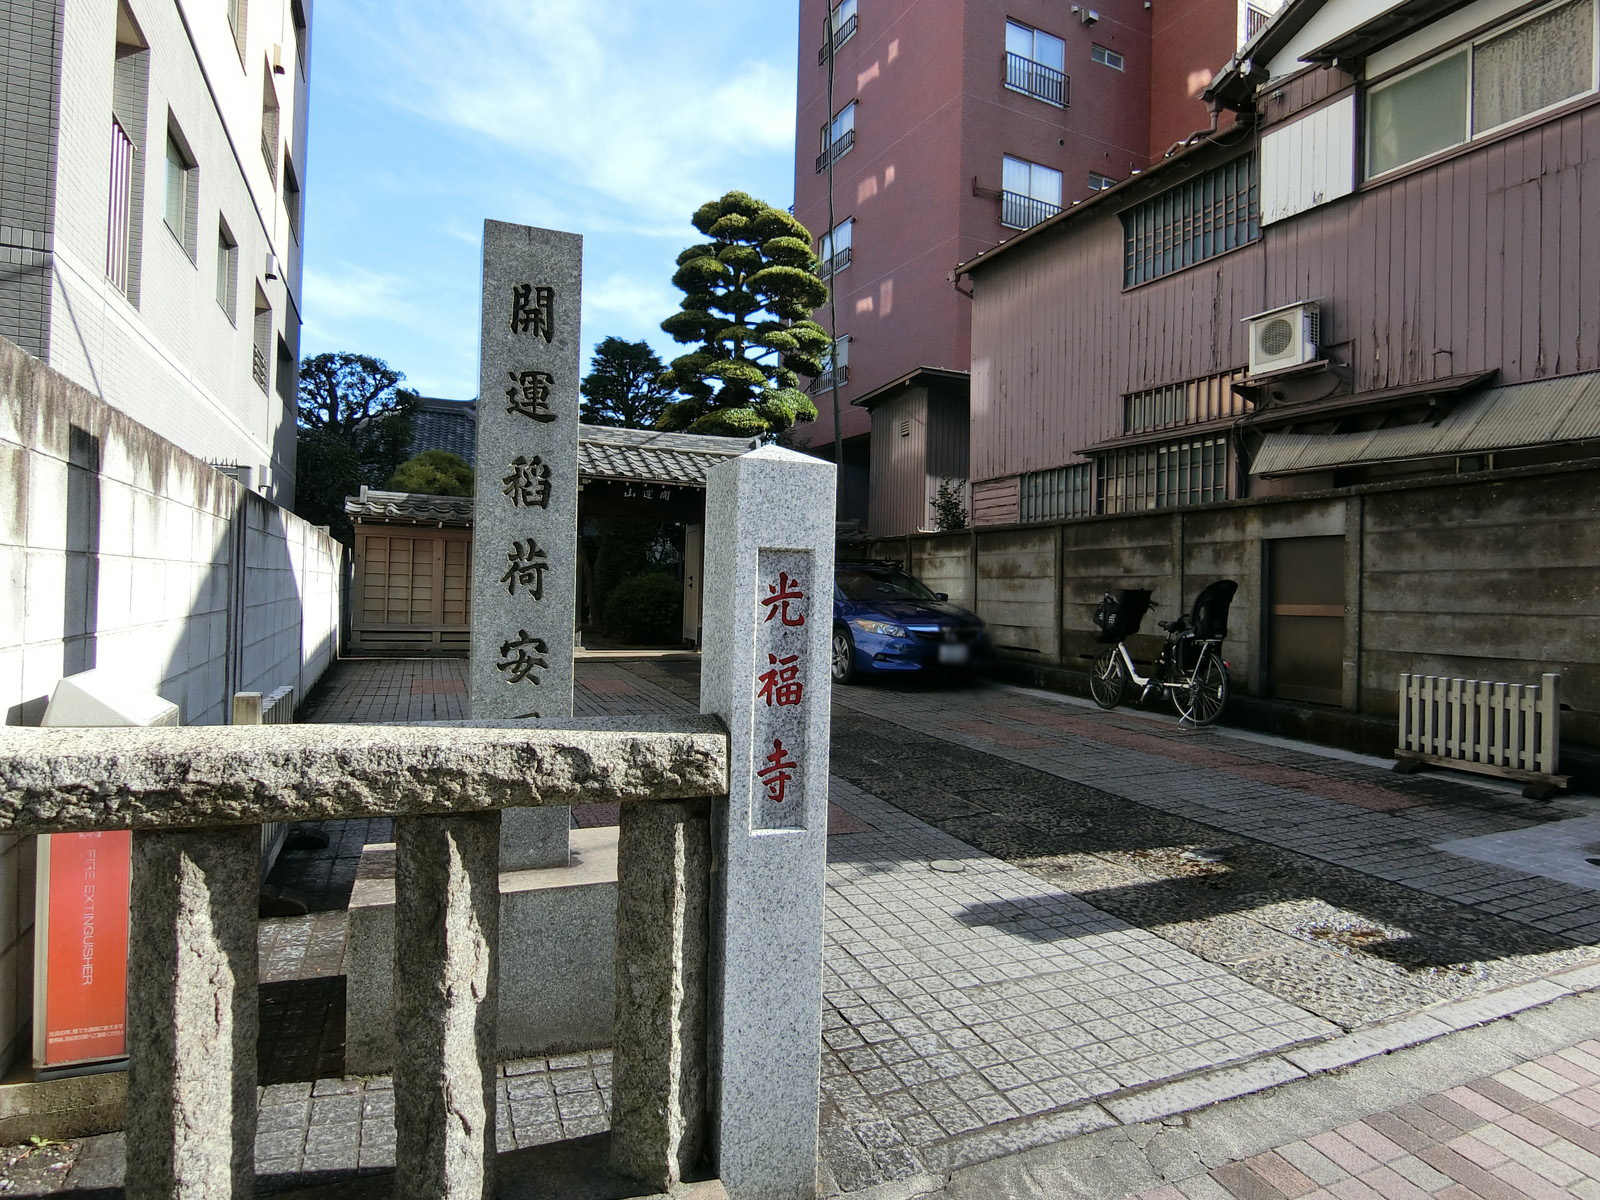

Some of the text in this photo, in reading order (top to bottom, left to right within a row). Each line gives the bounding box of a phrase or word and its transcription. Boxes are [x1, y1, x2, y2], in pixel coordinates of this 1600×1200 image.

[756, 571, 805, 803] 光福寺
[84, 849, 96, 880] FIRE
[82, 884, 96, 986] EXTINGUISHER
